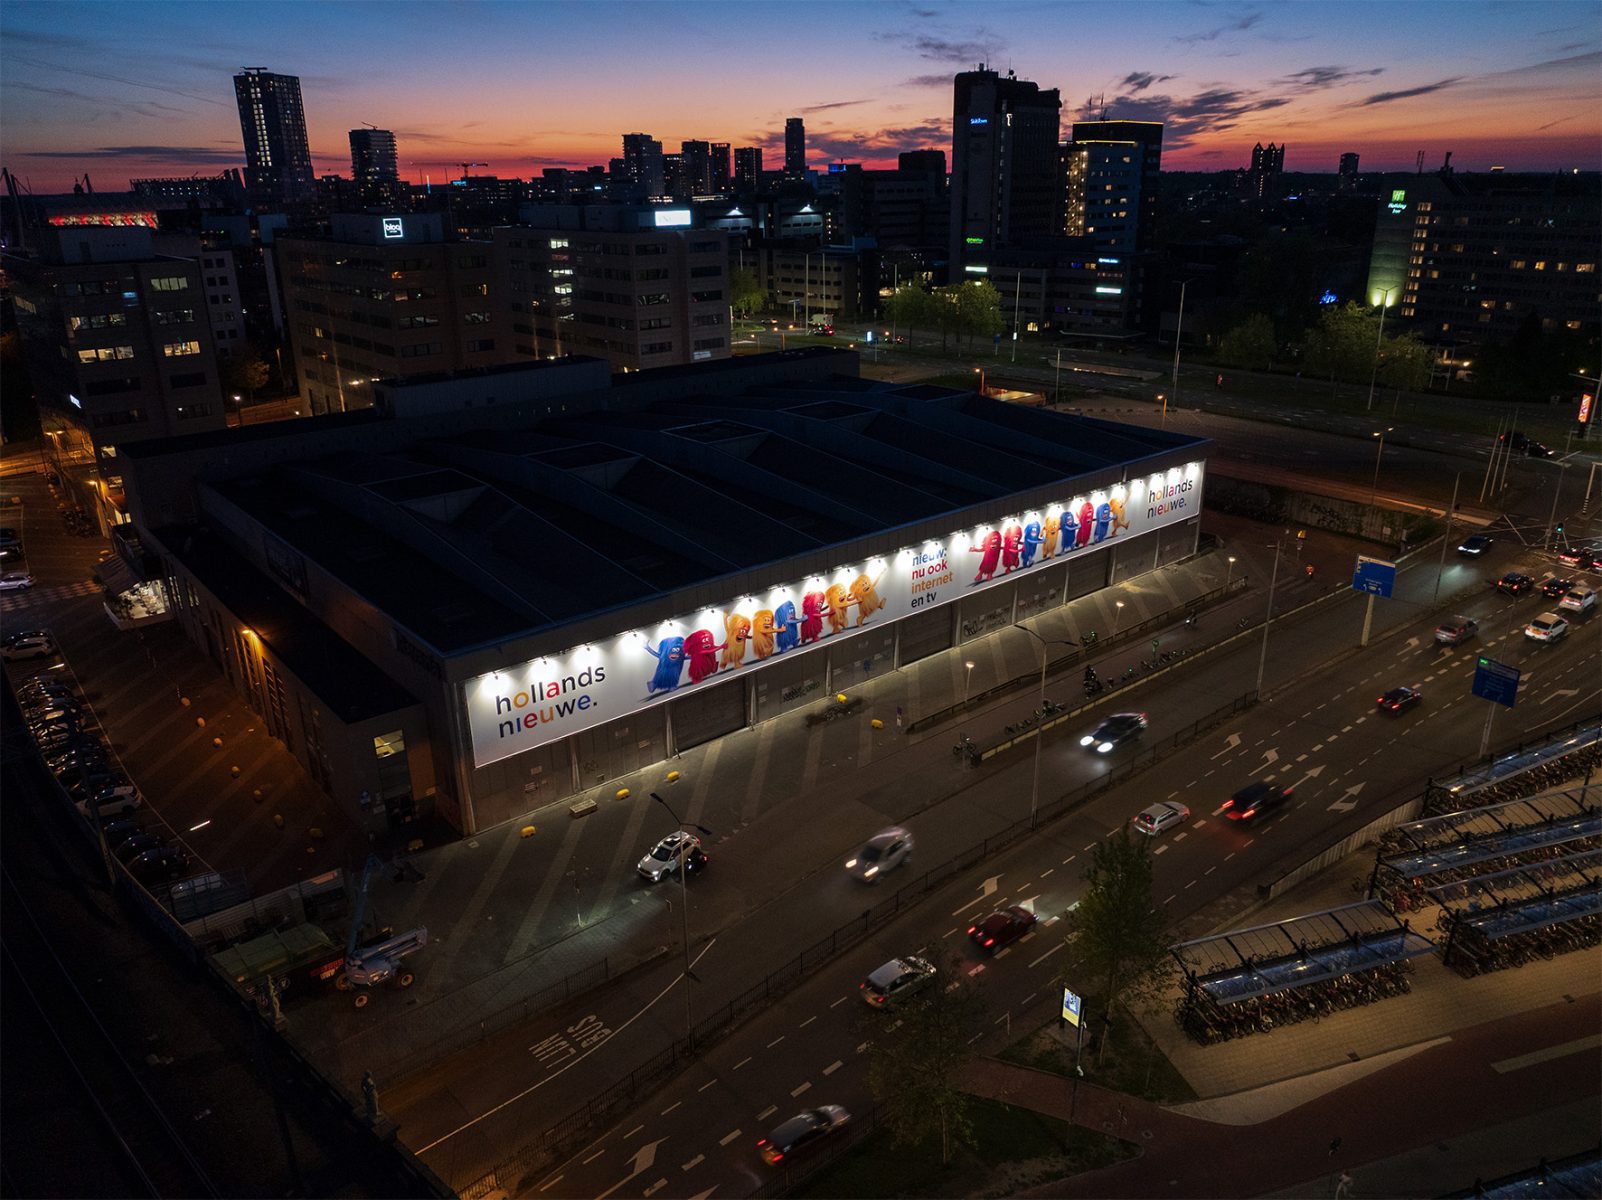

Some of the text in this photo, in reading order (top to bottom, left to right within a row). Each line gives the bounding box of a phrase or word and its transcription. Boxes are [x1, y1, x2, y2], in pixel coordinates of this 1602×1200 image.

[1148, 479, 1193, 503] hollands
[1147, 497, 1187, 519] nieuwe.
[912, 559, 948, 580] nu ook
[912, 571, 954, 594] internet
[911, 592, 937, 608] en tv
[496, 666, 606, 715] hollands
[499, 694, 598, 738] nieuwe.
[566, 1014, 612, 1049] BUS
